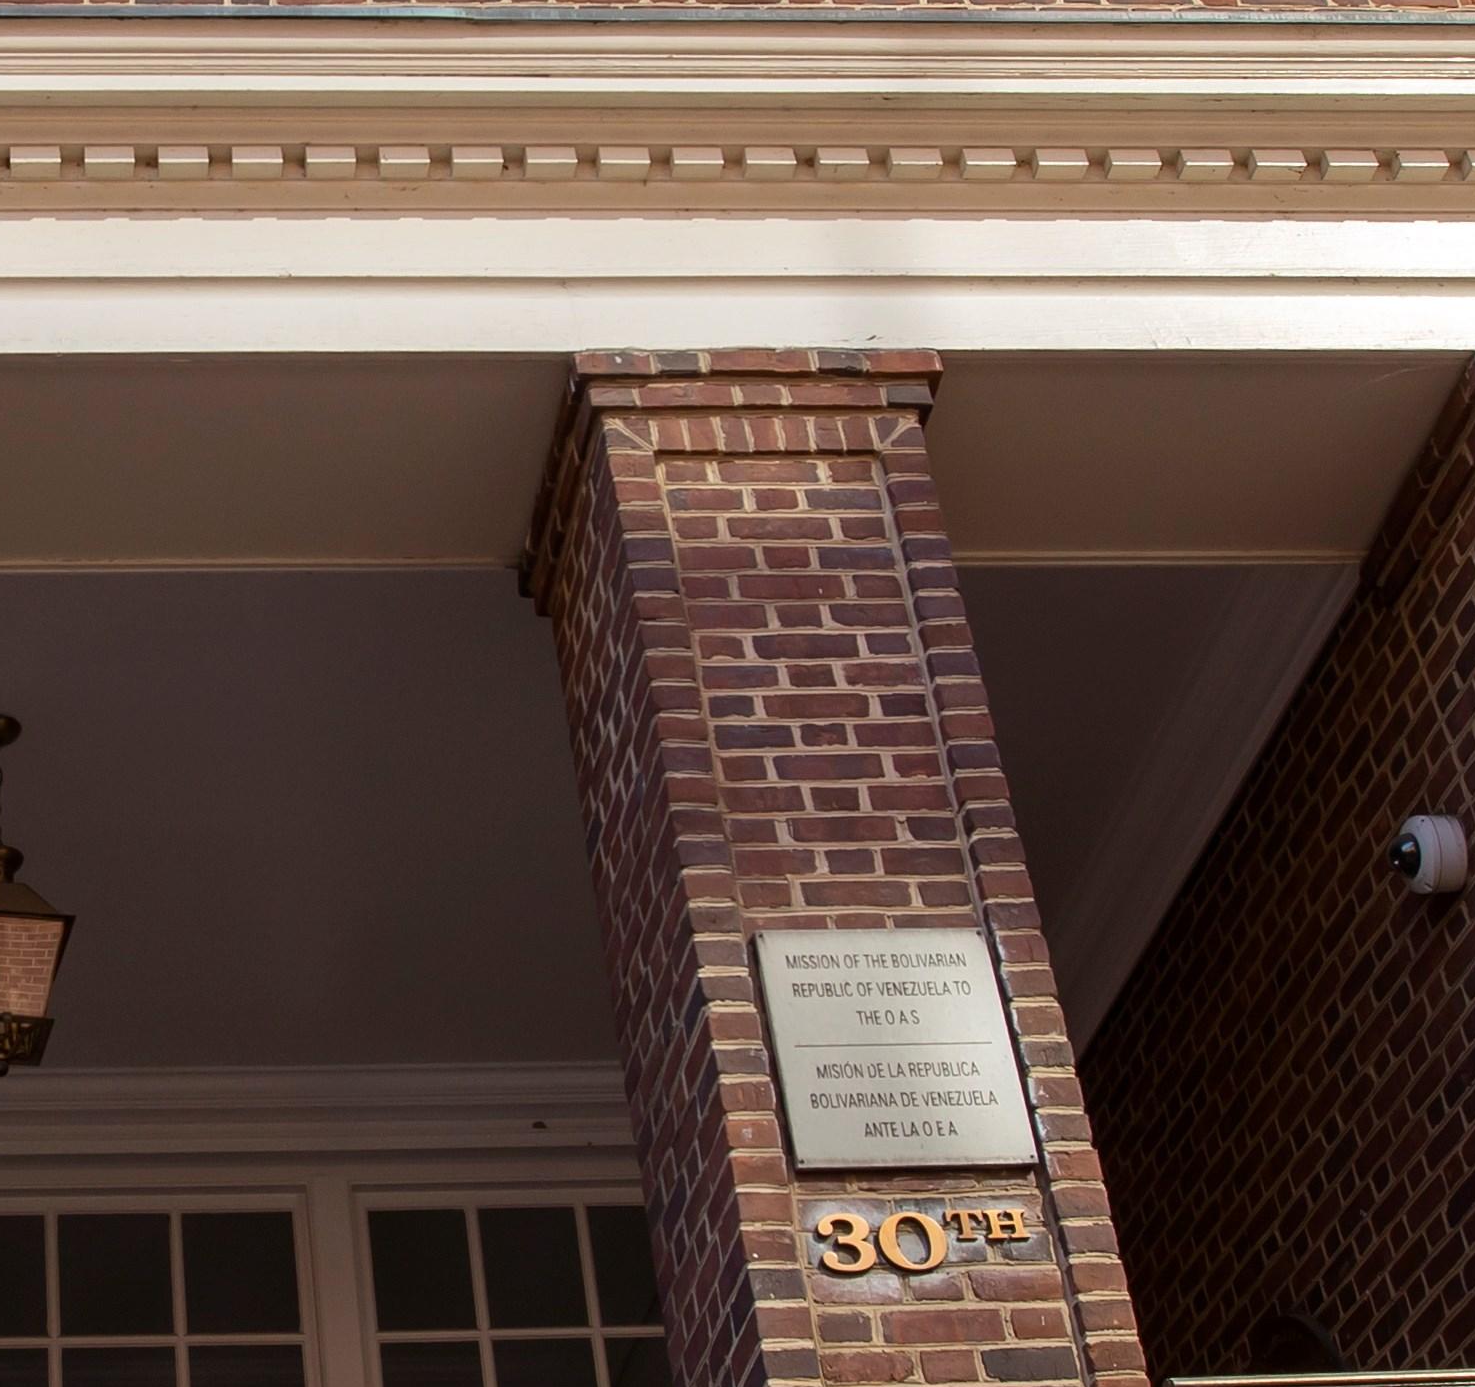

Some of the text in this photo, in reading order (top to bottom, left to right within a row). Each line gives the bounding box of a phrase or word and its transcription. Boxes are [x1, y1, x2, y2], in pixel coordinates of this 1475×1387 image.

[784, 952, 968, 970] MISSION OF THE BOLIVARIAN
[791, 980, 972, 998] REPUBLIC OF VENEZUELA TO
[855, 1010, 883, 1026] THE
[816, 1060, 981, 1080] MISIÓN DE LA REPUBLICA
[809, 1090, 1000, 1110] BOLIVARIANA DE VENEZUELA
[863, 1121, 900, 1138] ANTE
[900, 1121, 921, 1138] LA
